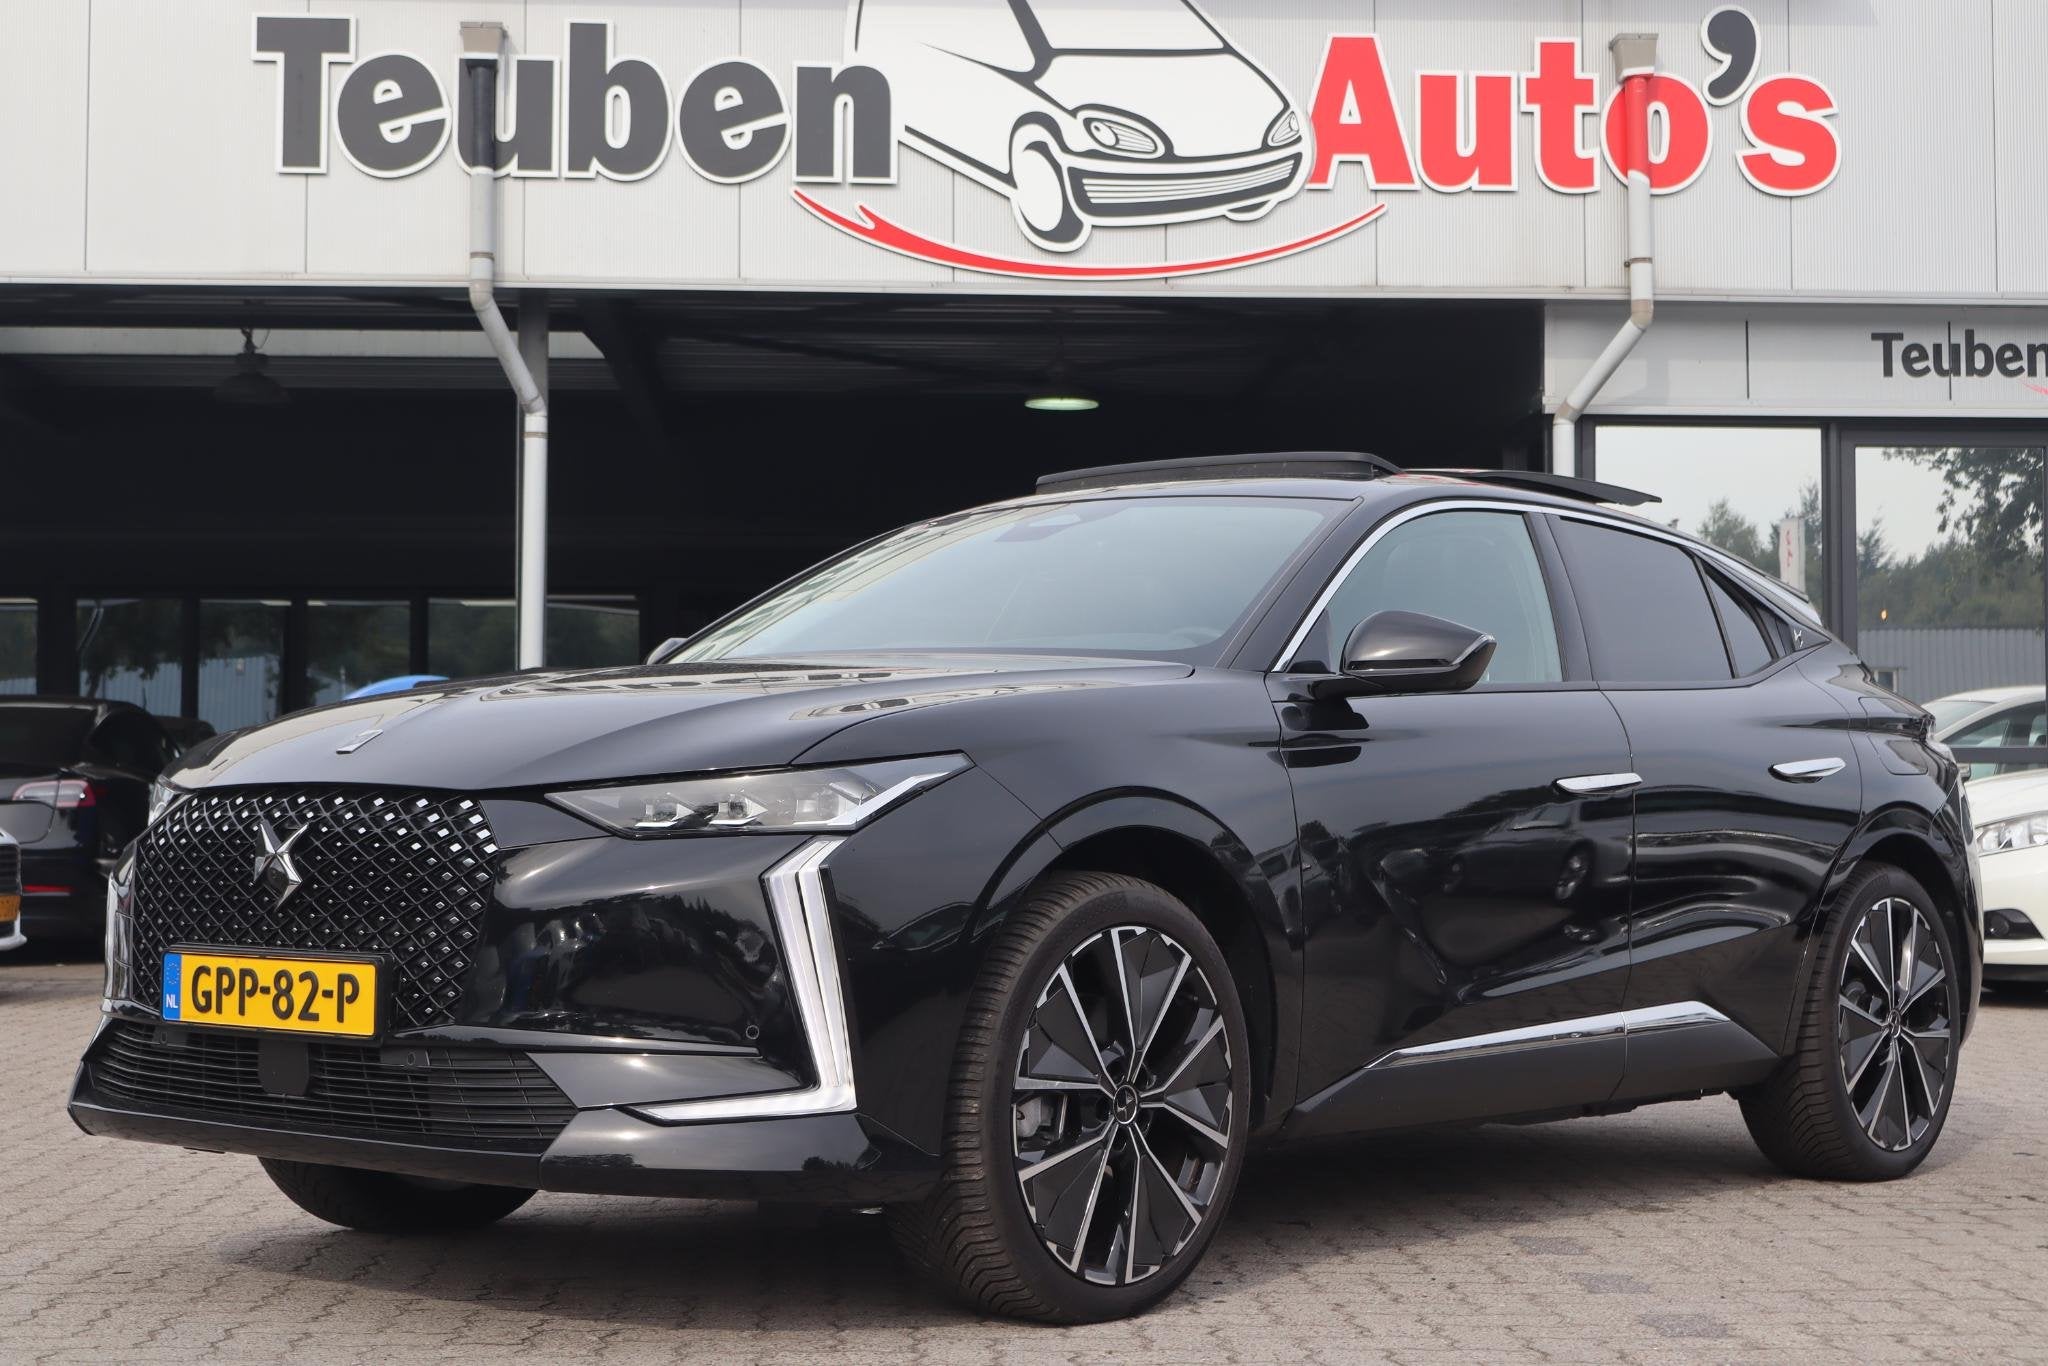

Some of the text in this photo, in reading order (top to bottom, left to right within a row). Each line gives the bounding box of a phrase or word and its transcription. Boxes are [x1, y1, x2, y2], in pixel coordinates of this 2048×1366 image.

[253, 5, 1841, 195] Teuben Auto's
[1871, 328, 2048, 378] Teuben
[166, 993, 179, 1009] NL
[191, 965, 360, 1023] GPP-82-P
